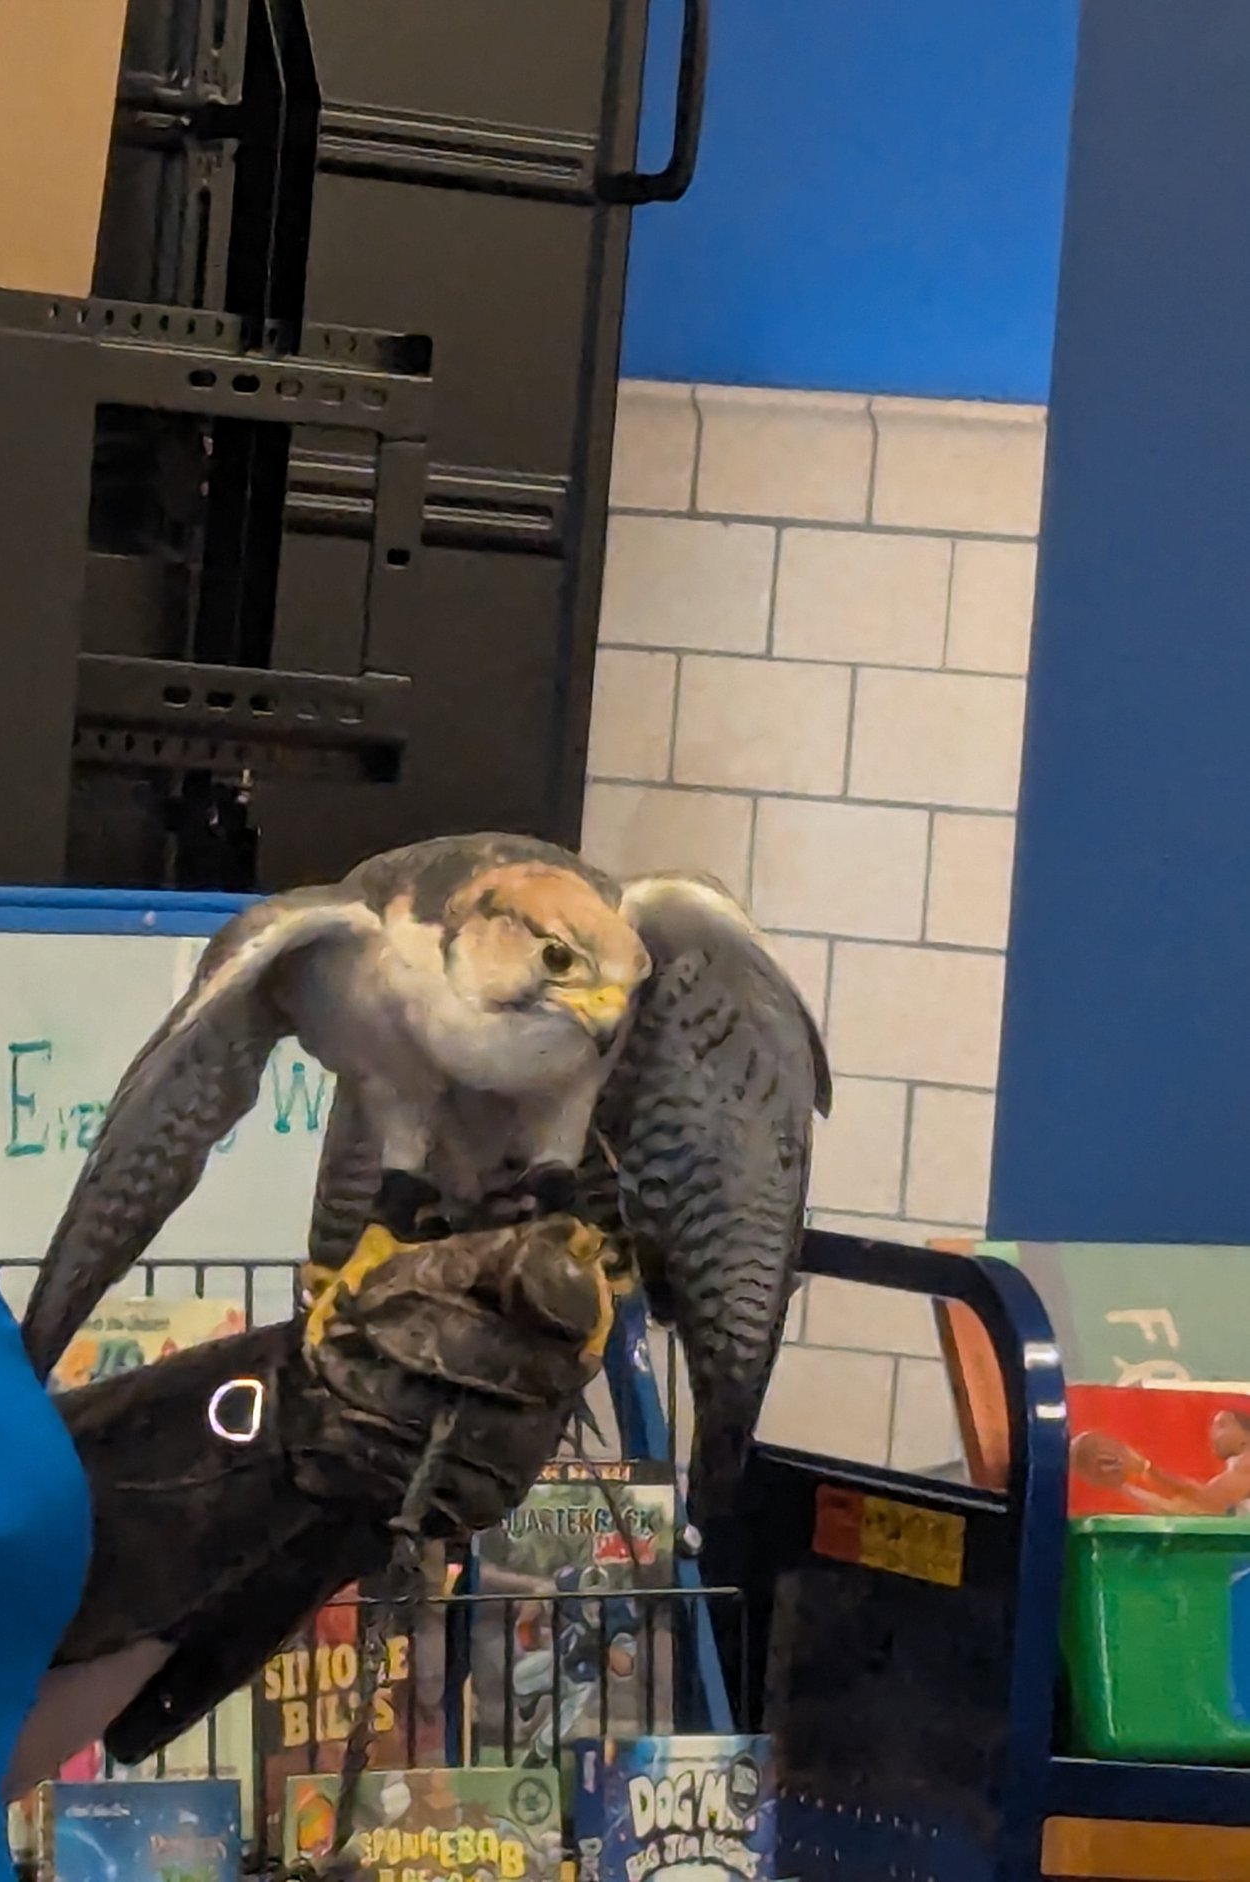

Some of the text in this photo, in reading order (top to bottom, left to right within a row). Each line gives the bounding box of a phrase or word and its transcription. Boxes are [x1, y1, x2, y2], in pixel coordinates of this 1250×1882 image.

[264, 1634, 410, 1701] SIMOE
[282, 1686, 395, 1748] BILS
[628, 1769, 695, 1838] DOG
